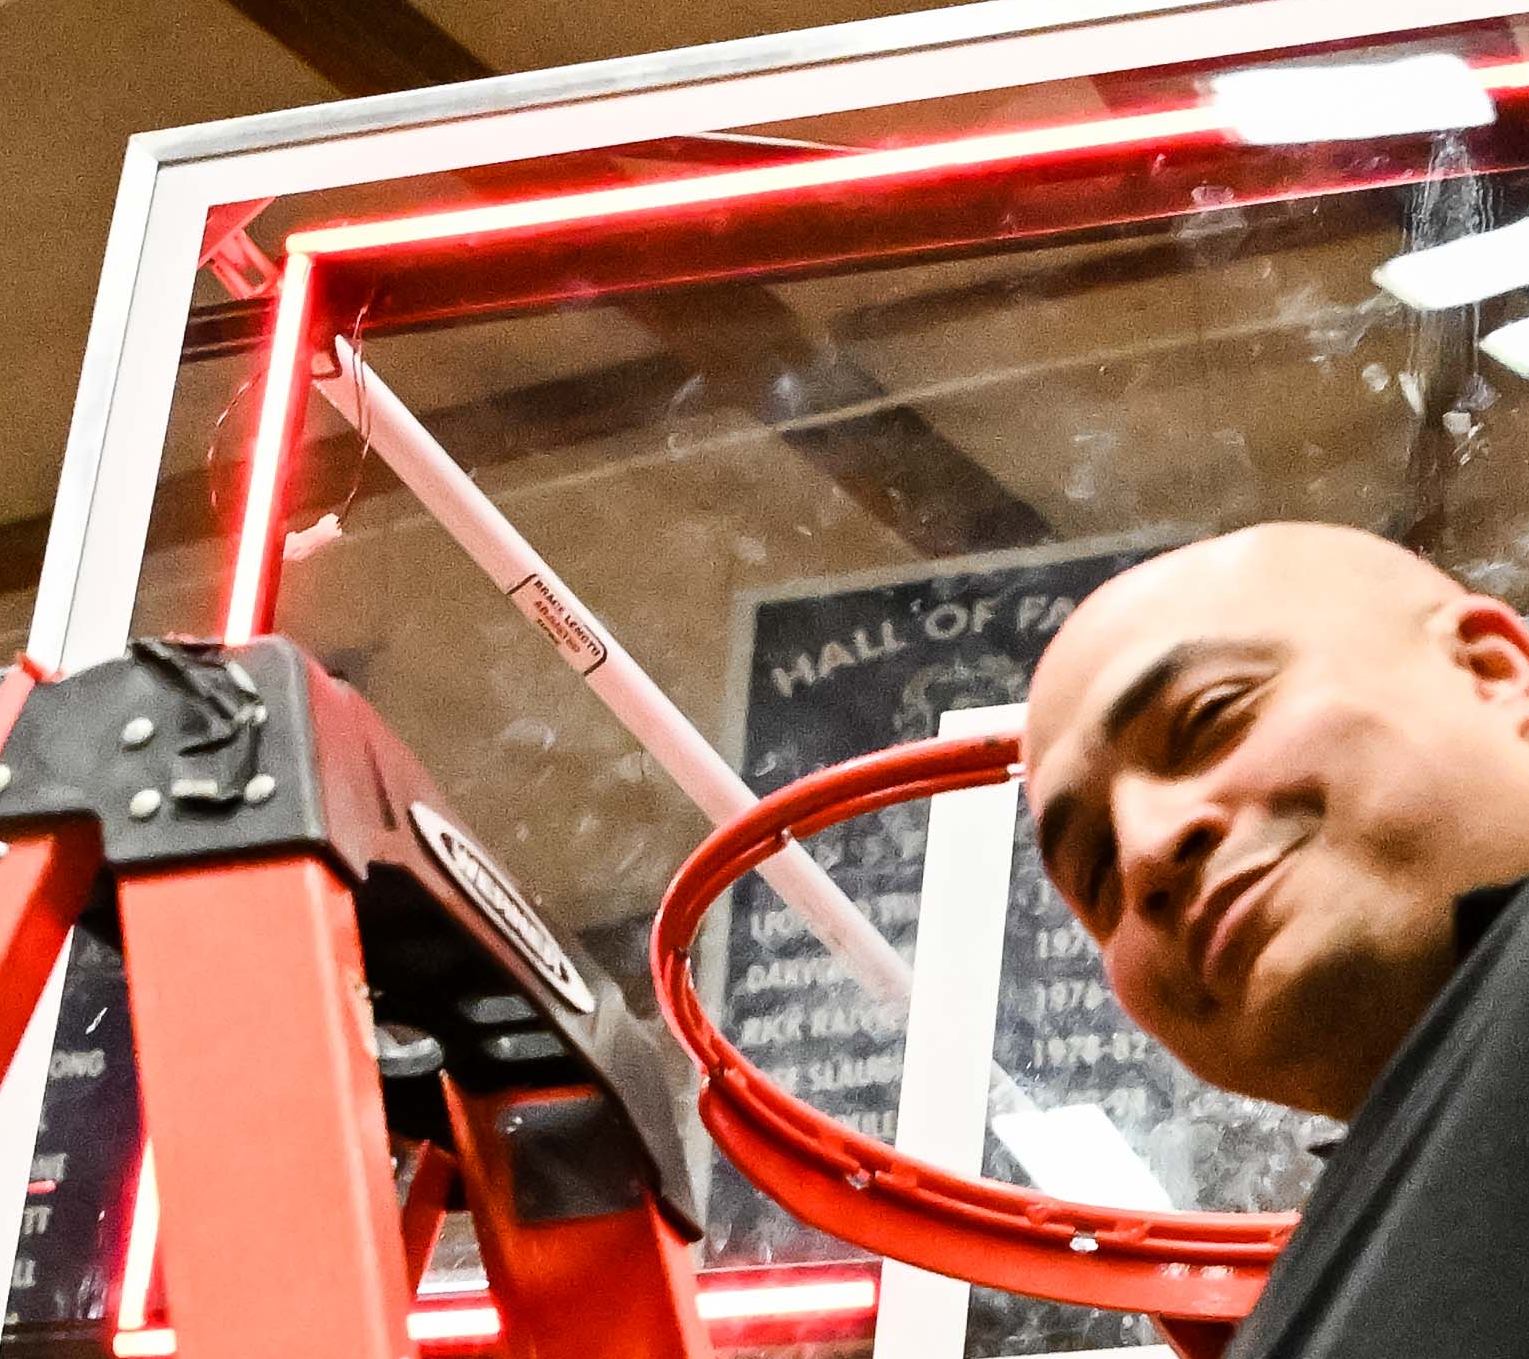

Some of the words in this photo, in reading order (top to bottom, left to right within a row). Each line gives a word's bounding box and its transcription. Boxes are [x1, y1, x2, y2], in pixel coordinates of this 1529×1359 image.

[771, 619, 906, 698] HALL
[924, 596, 996, 640] OF
[1016, 593, 1076, 633] FA
